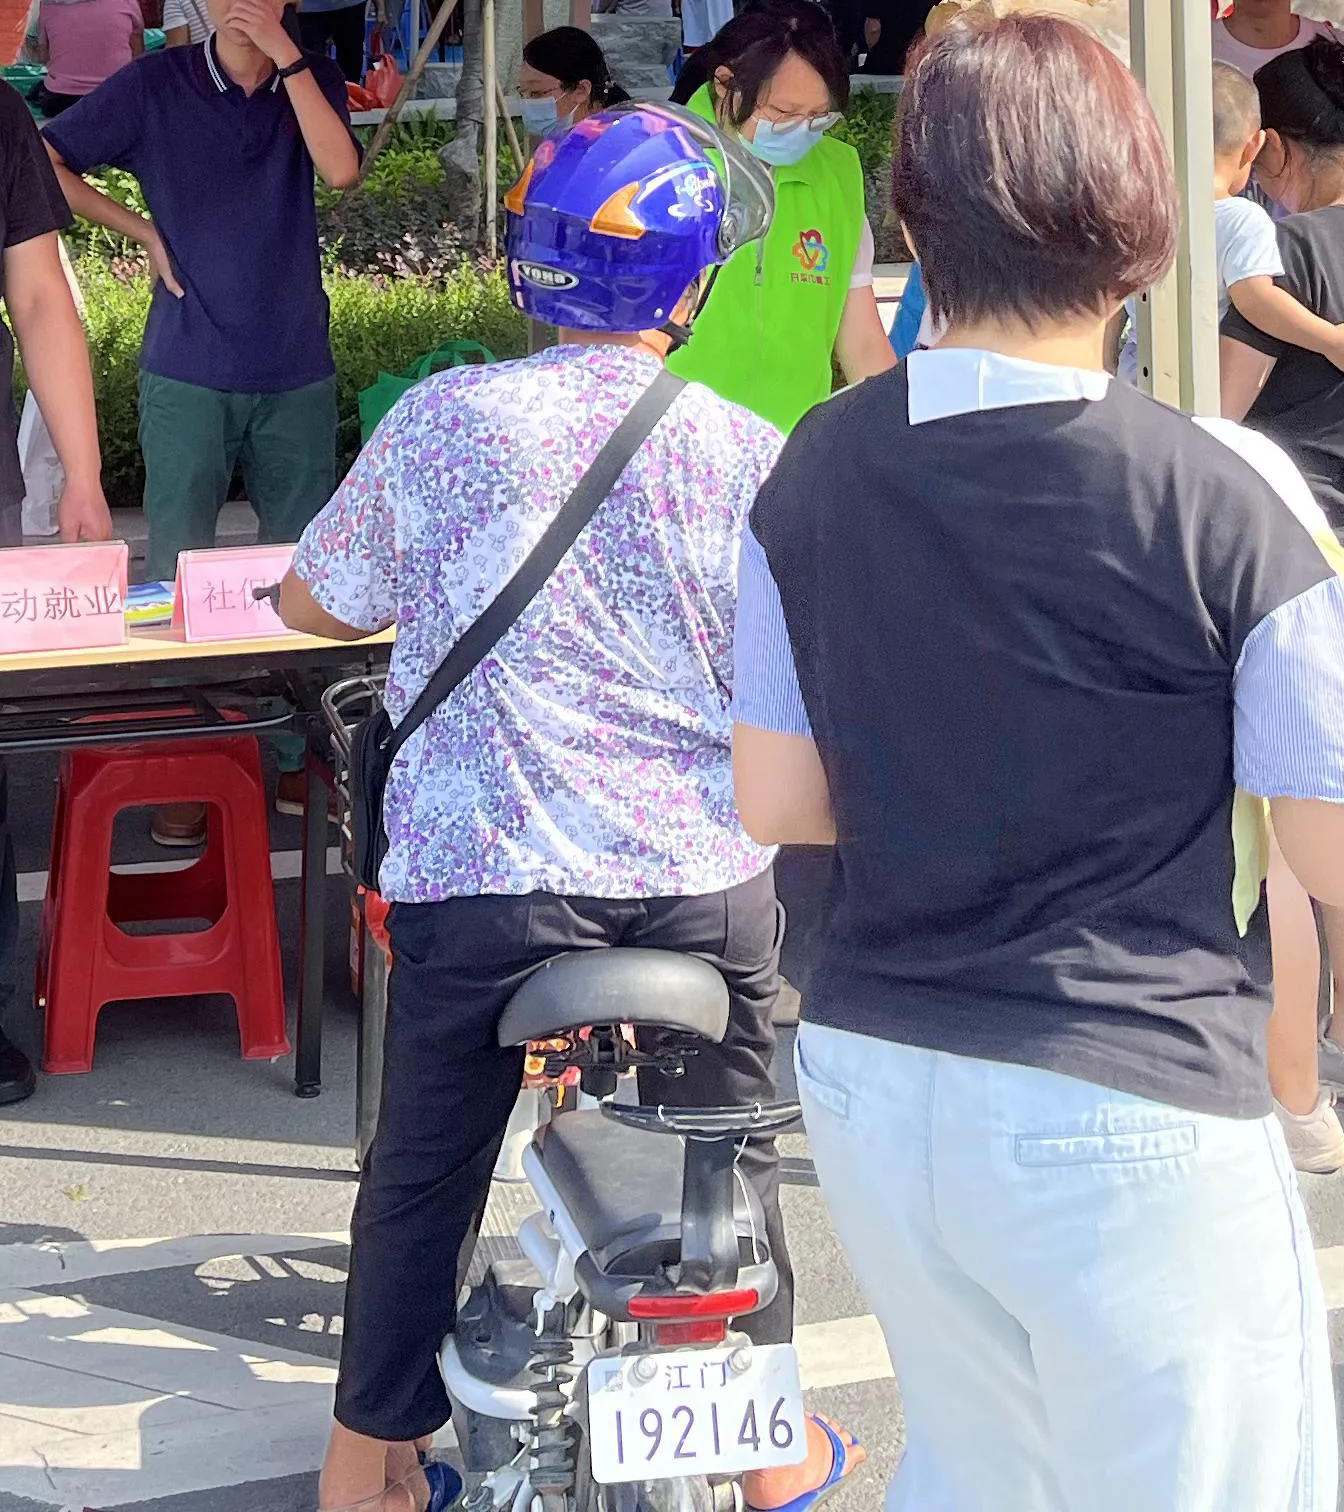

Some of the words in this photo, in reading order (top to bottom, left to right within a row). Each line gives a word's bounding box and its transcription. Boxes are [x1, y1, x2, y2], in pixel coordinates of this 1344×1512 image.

[202, 577, 278, 614] 社保
[665, 1360, 727, 1391] 江门
[615, 1395, 794, 1465] 192146
